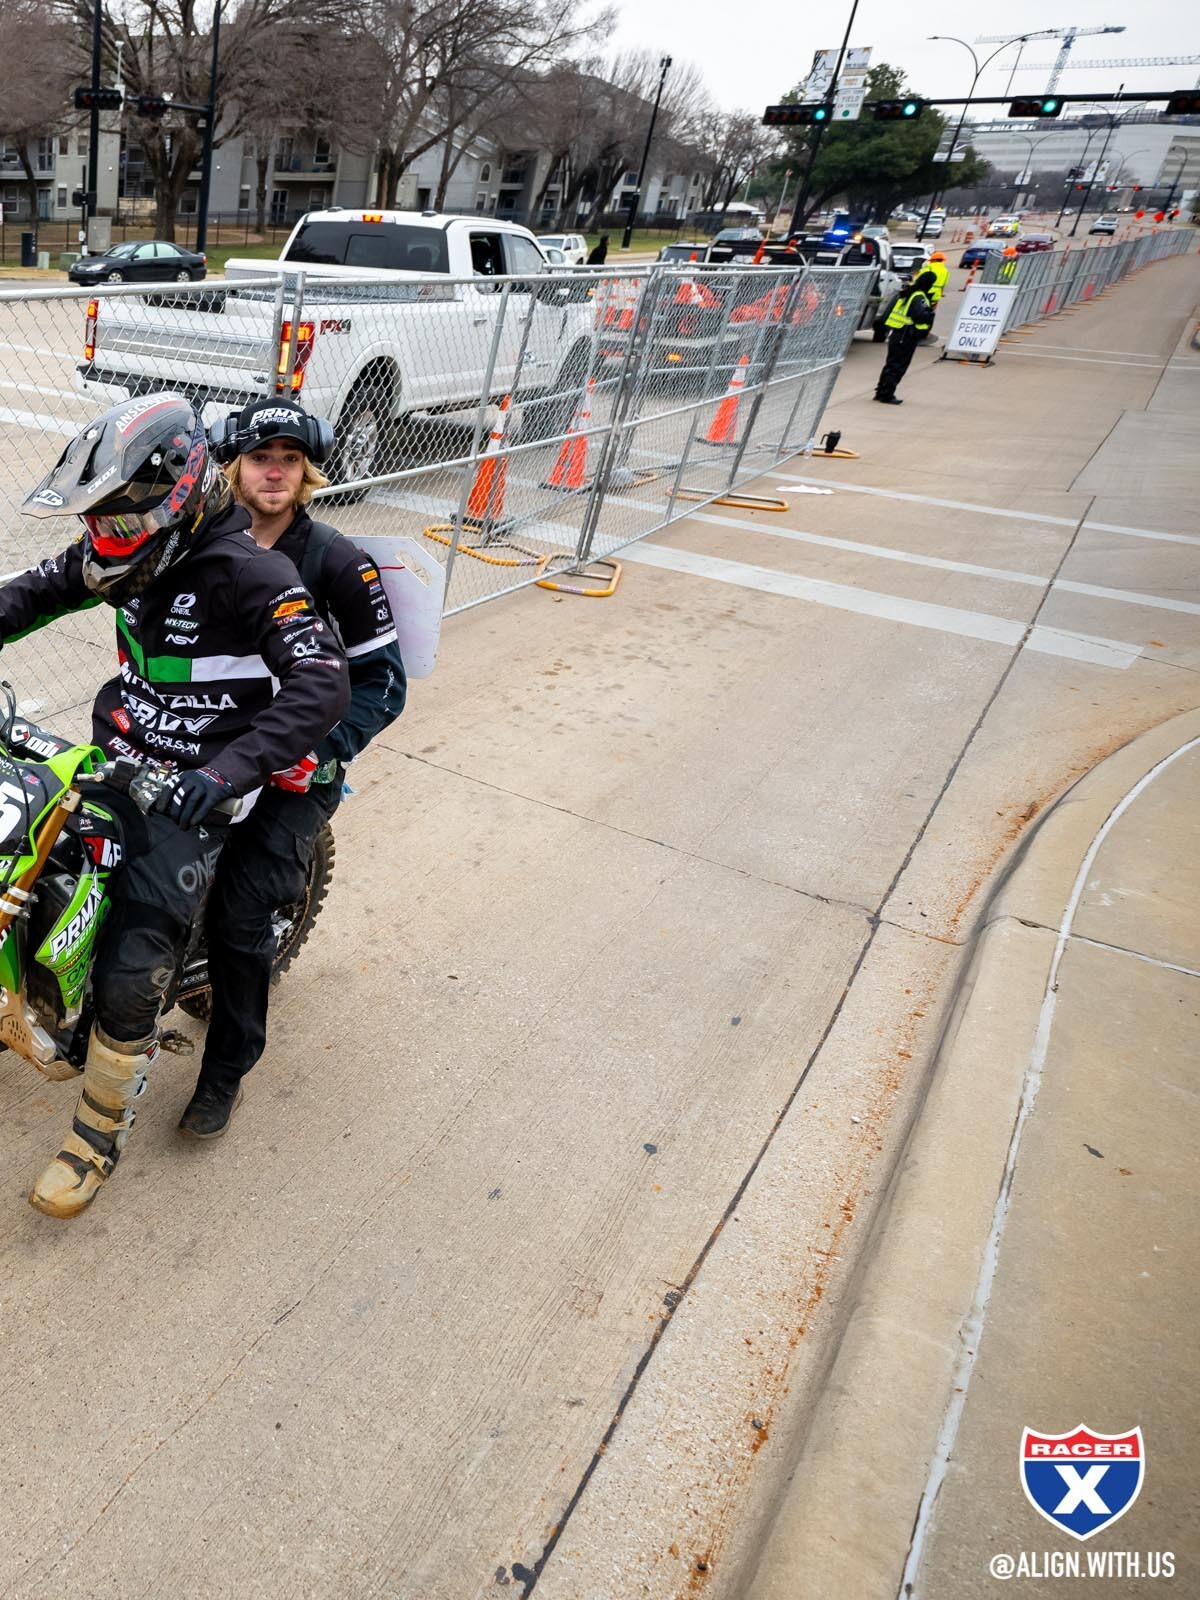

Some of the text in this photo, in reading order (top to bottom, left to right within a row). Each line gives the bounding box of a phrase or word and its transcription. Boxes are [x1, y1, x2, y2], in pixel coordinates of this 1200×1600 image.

[981, 292, 997, 303] NO
[969, 306, 999, 317] CASH
[958, 322, 997, 334] PERMIT
[958, 336, 986, 348] ONLY
[250, 407, 303, 427] PRMX
